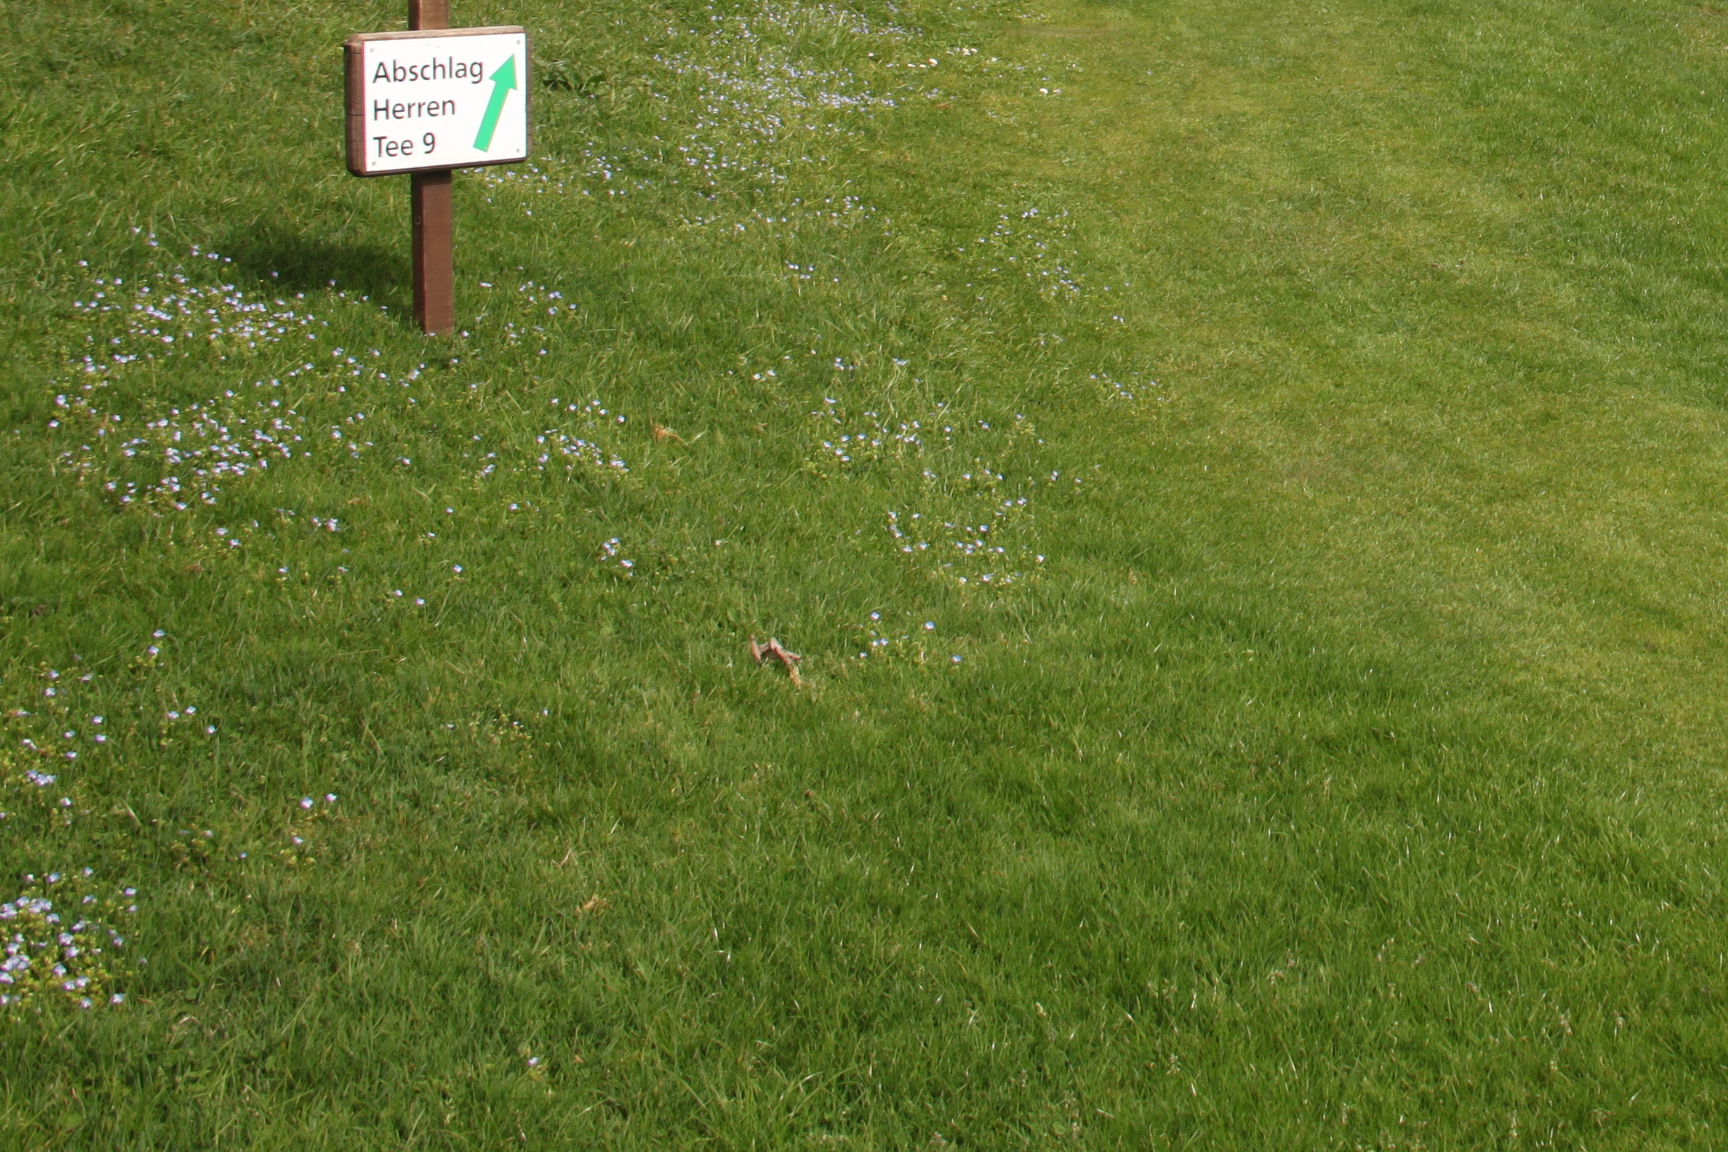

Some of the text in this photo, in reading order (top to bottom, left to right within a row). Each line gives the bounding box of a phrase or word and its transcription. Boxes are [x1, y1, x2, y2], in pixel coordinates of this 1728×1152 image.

[372, 55, 484, 85] Abschlag
[373, 98, 456, 121] Herren
[373, 132, 436, 158] Tee 9
